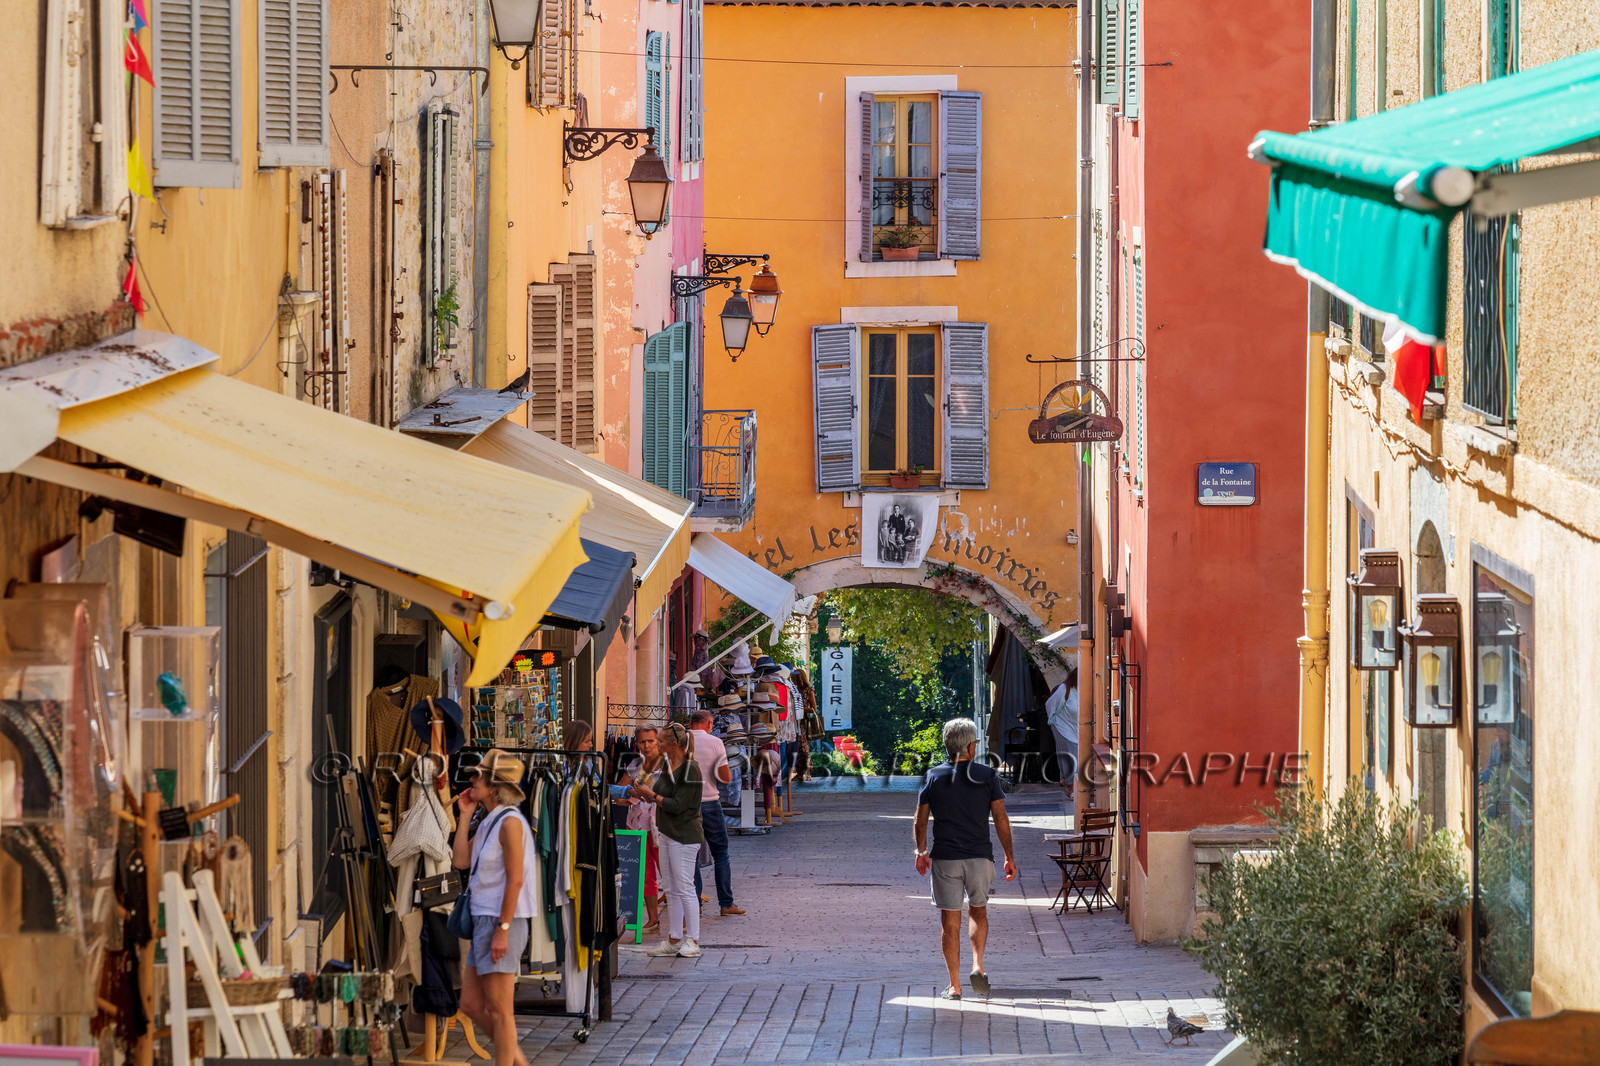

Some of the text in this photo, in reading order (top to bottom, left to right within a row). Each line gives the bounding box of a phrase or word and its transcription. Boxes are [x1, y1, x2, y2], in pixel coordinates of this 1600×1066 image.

[1036, 430, 1047, 440] Le
[1080, 428, 1115, 441] d'Eugène
[830, 650, 844, 728] GALERIE
